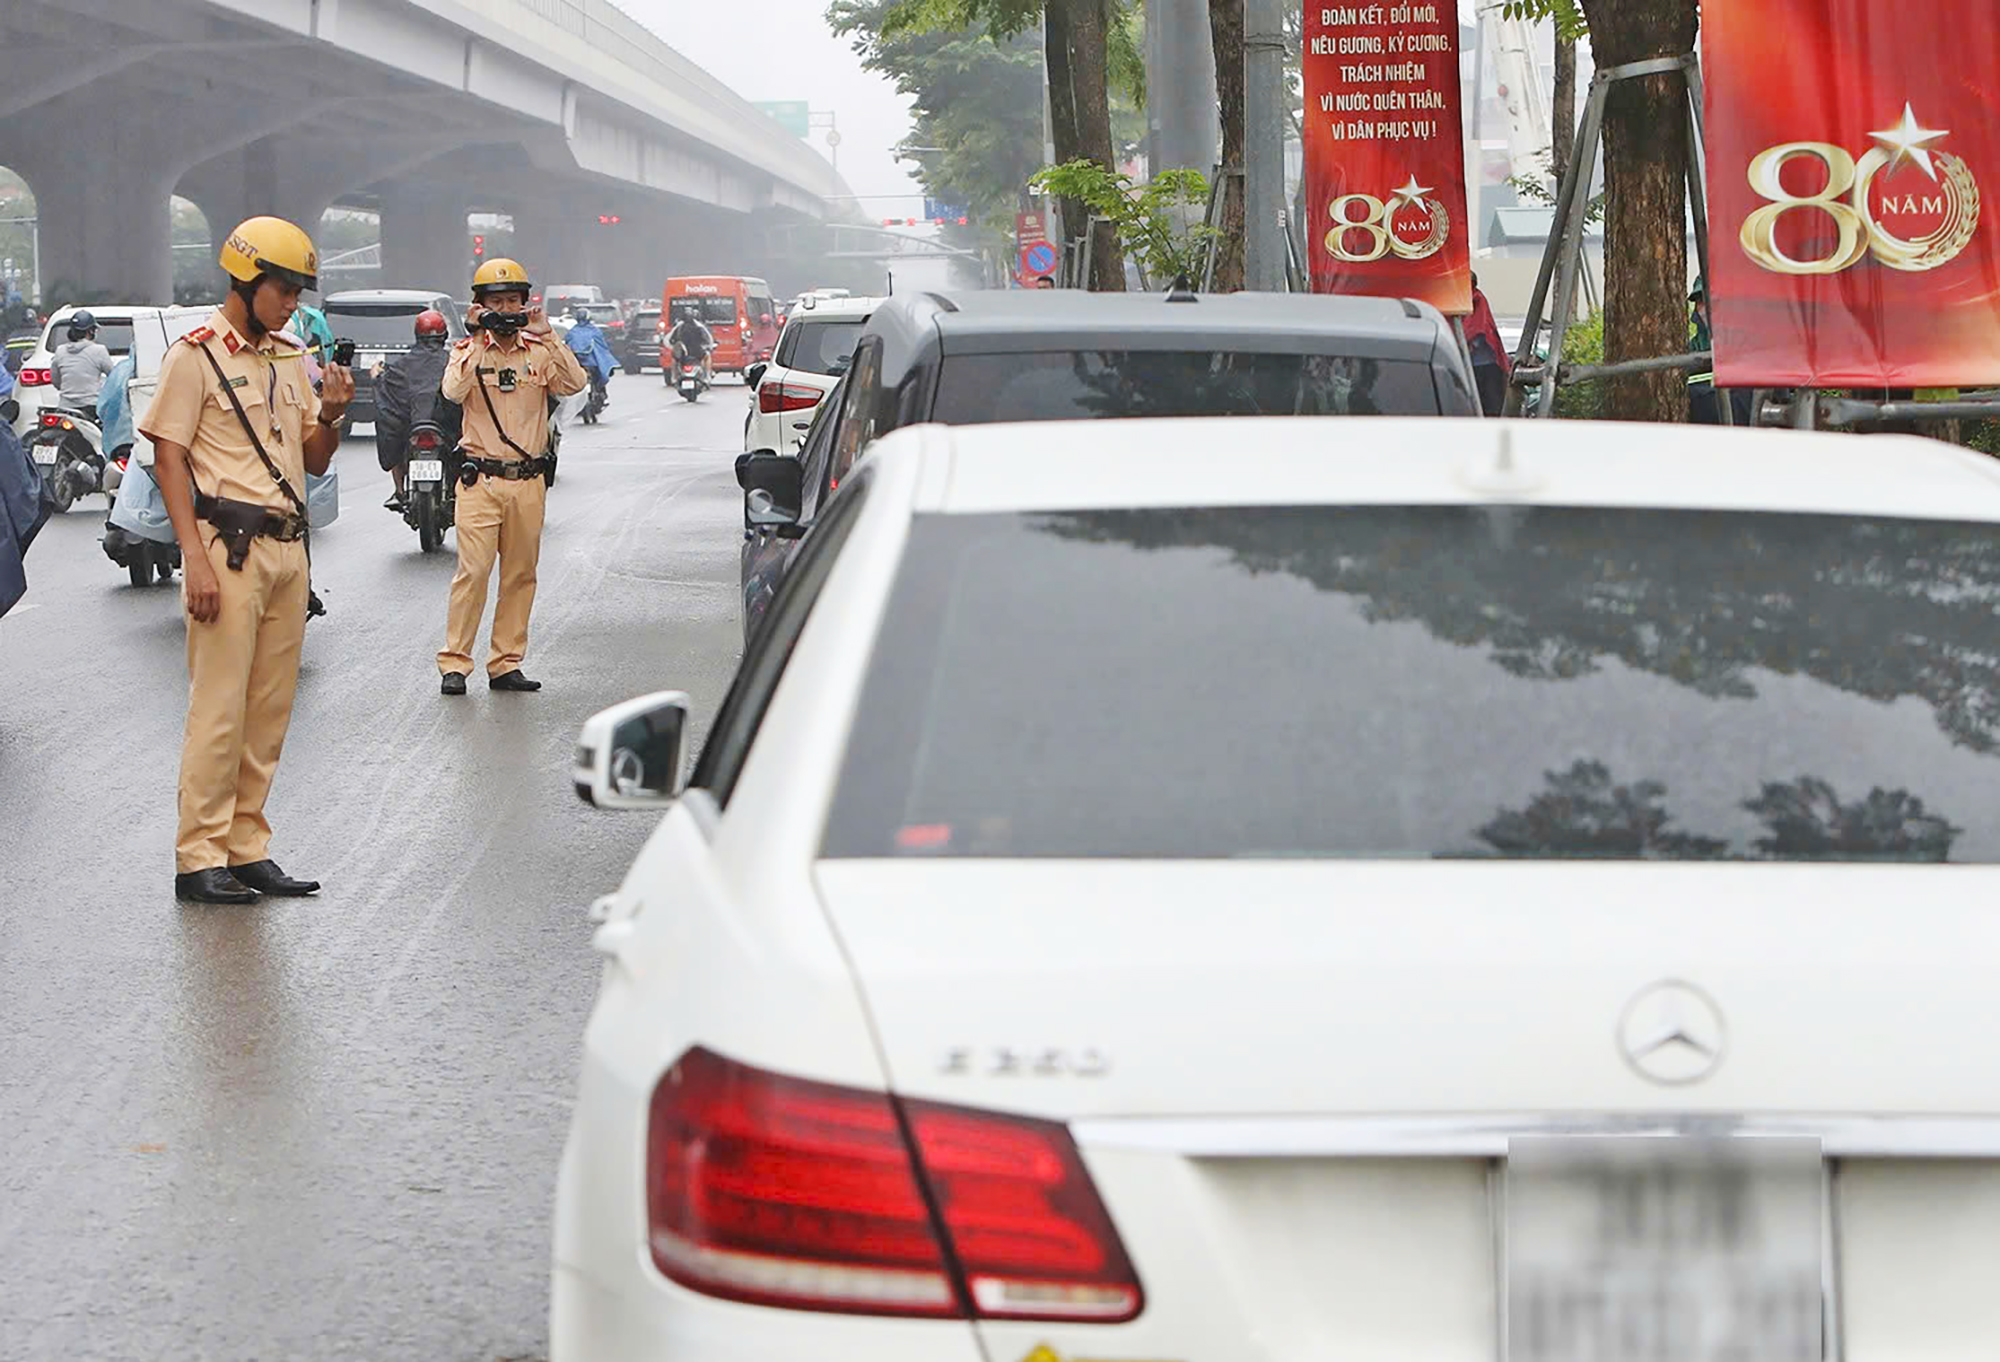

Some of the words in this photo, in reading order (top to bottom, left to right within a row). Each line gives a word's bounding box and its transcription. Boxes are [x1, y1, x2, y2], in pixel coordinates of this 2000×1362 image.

[1322, 6, 1356, 26] ĐOÀN
[1359, 3, 1388, 26] KẾT,
[1391, 0, 1410, 24] ĐỔI
[1413, 4, 1440, 25] MỚI,
[1311, 35, 1336, 54] NÊU
[1339, 36, 1385, 54] GƯƠNG,
[1388, 30, 1405, 52] KỶ
[1407, 34, 1452, 52] CƯƠNG,
[1340, 62, 1382, 82] TRÁCH
[1385, 61, 1425, 83] NHIỆM
[1320, 92, 1333, 111] VÌ
[1336, 91, 1370, 111] NƯỚC
[1373, 90, 1406, 111] QUÊN
[1409, 89, 1446, 110] THÂN,
[1332, 120, 1345, 140] VÌ
[1348, 120, 1374, 140] DÂN
[1377, 121, 1409, 141] PHỤC
[1412, 121, 1429, 141] VỤ
[1882, 194, 1943, 215] NĂM
[1397, 221, 1430, 232] NĂM
